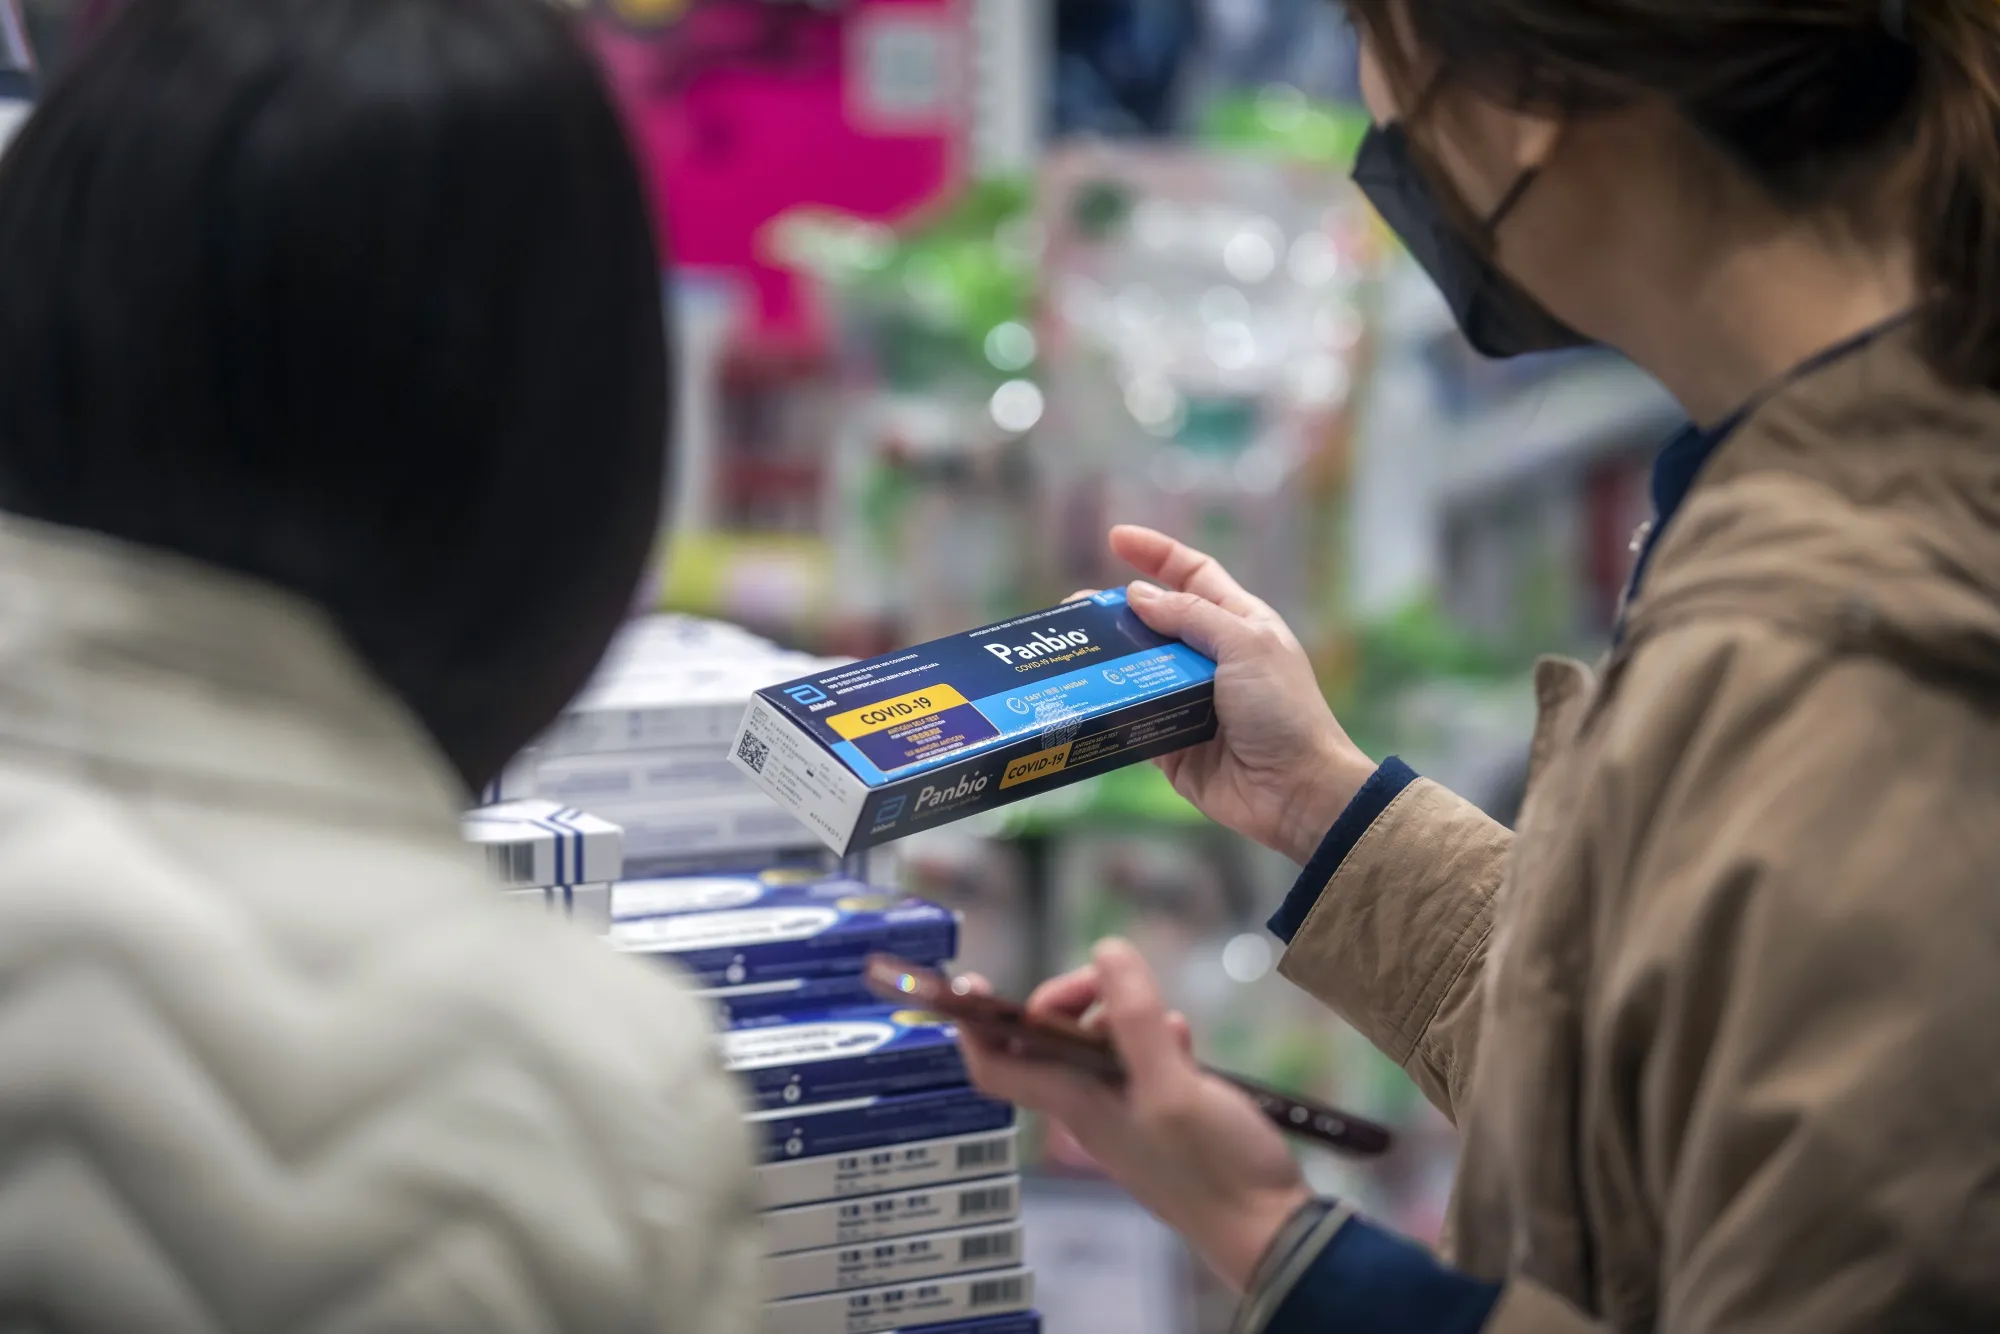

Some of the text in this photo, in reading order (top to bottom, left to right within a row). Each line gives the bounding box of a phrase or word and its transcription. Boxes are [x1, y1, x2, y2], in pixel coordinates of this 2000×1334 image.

[984, 628, 1088, 664] Panbio
[1015, 659, 1049, 673] COVID-19
[1050, 651, 1074, 662] Antigen
[1024, 692, 1041, 701] EASY
[1063, 680, 1088, 690] MUDAH
[860, 697, 932, 724] COVID-19
[1008, 752, 1065, 780] COVID-19
[914, 770, 988, 812] Panbio
